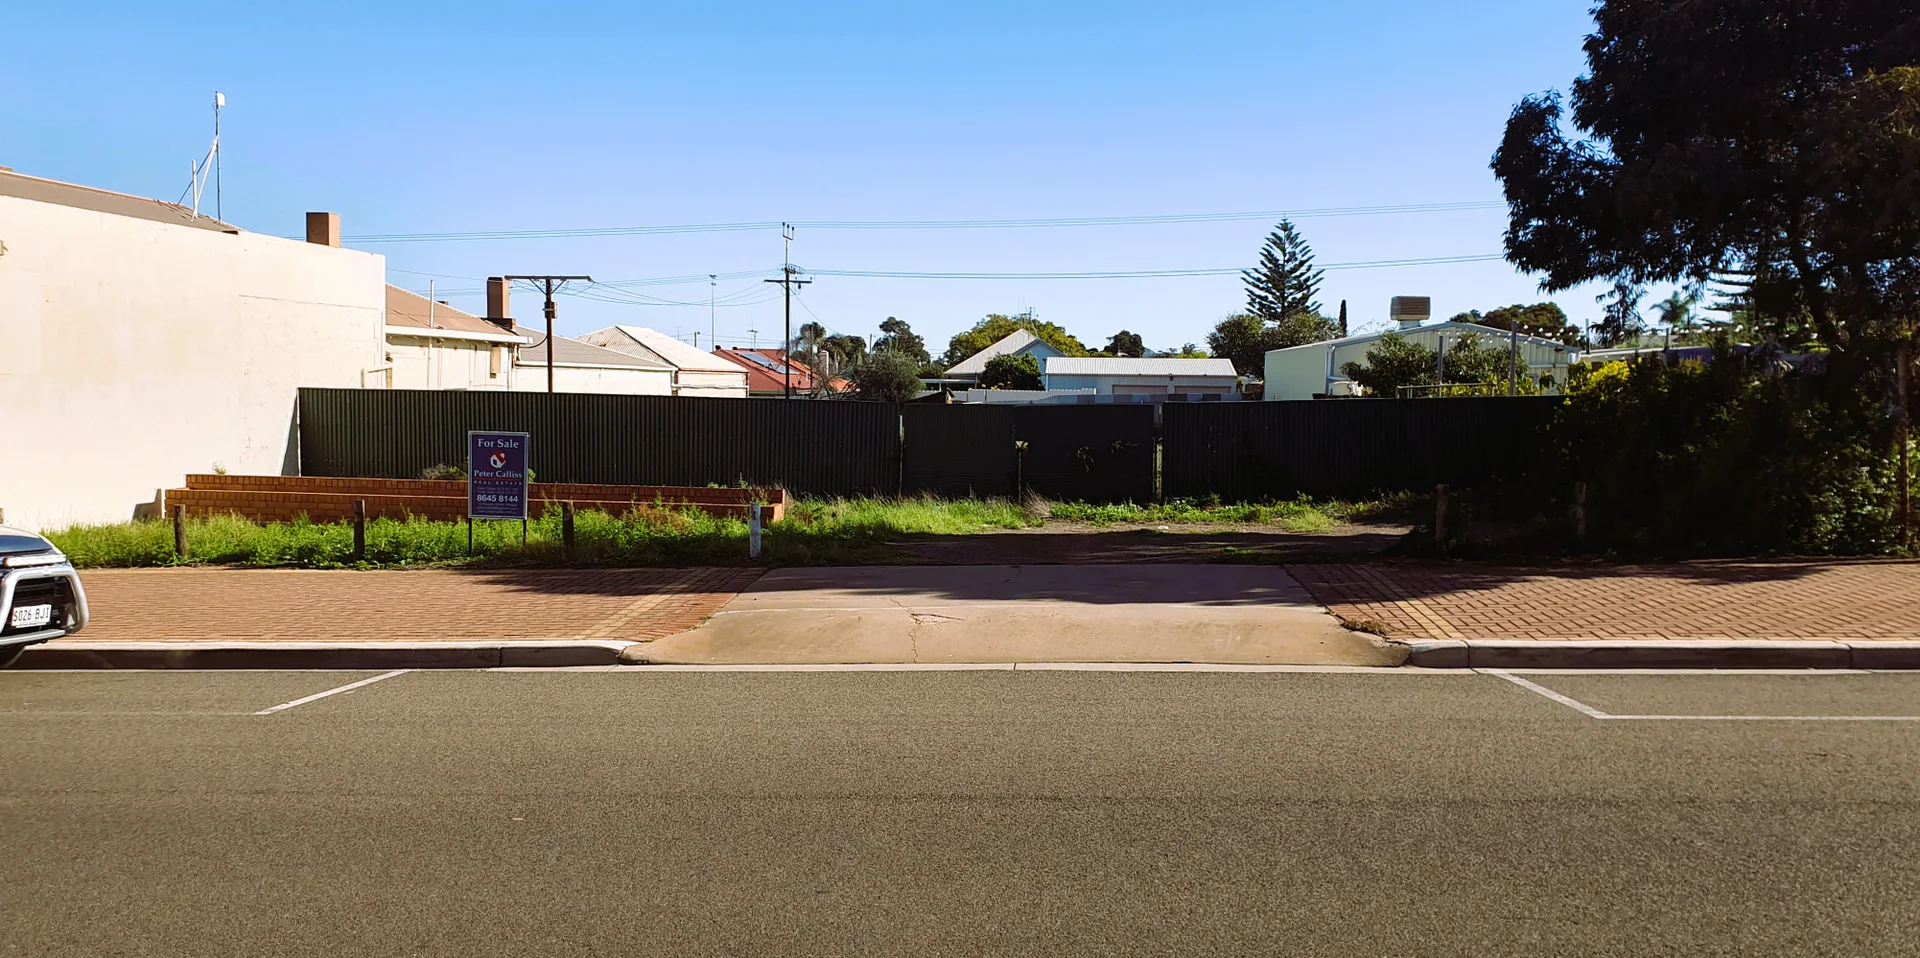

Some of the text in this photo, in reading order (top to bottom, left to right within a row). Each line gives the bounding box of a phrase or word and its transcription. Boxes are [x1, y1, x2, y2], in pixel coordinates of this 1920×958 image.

[478, 438, 519, 448] For Sale
[495, 470, 522, 478] Calliss
[477, 494, 497, 502] 8645
